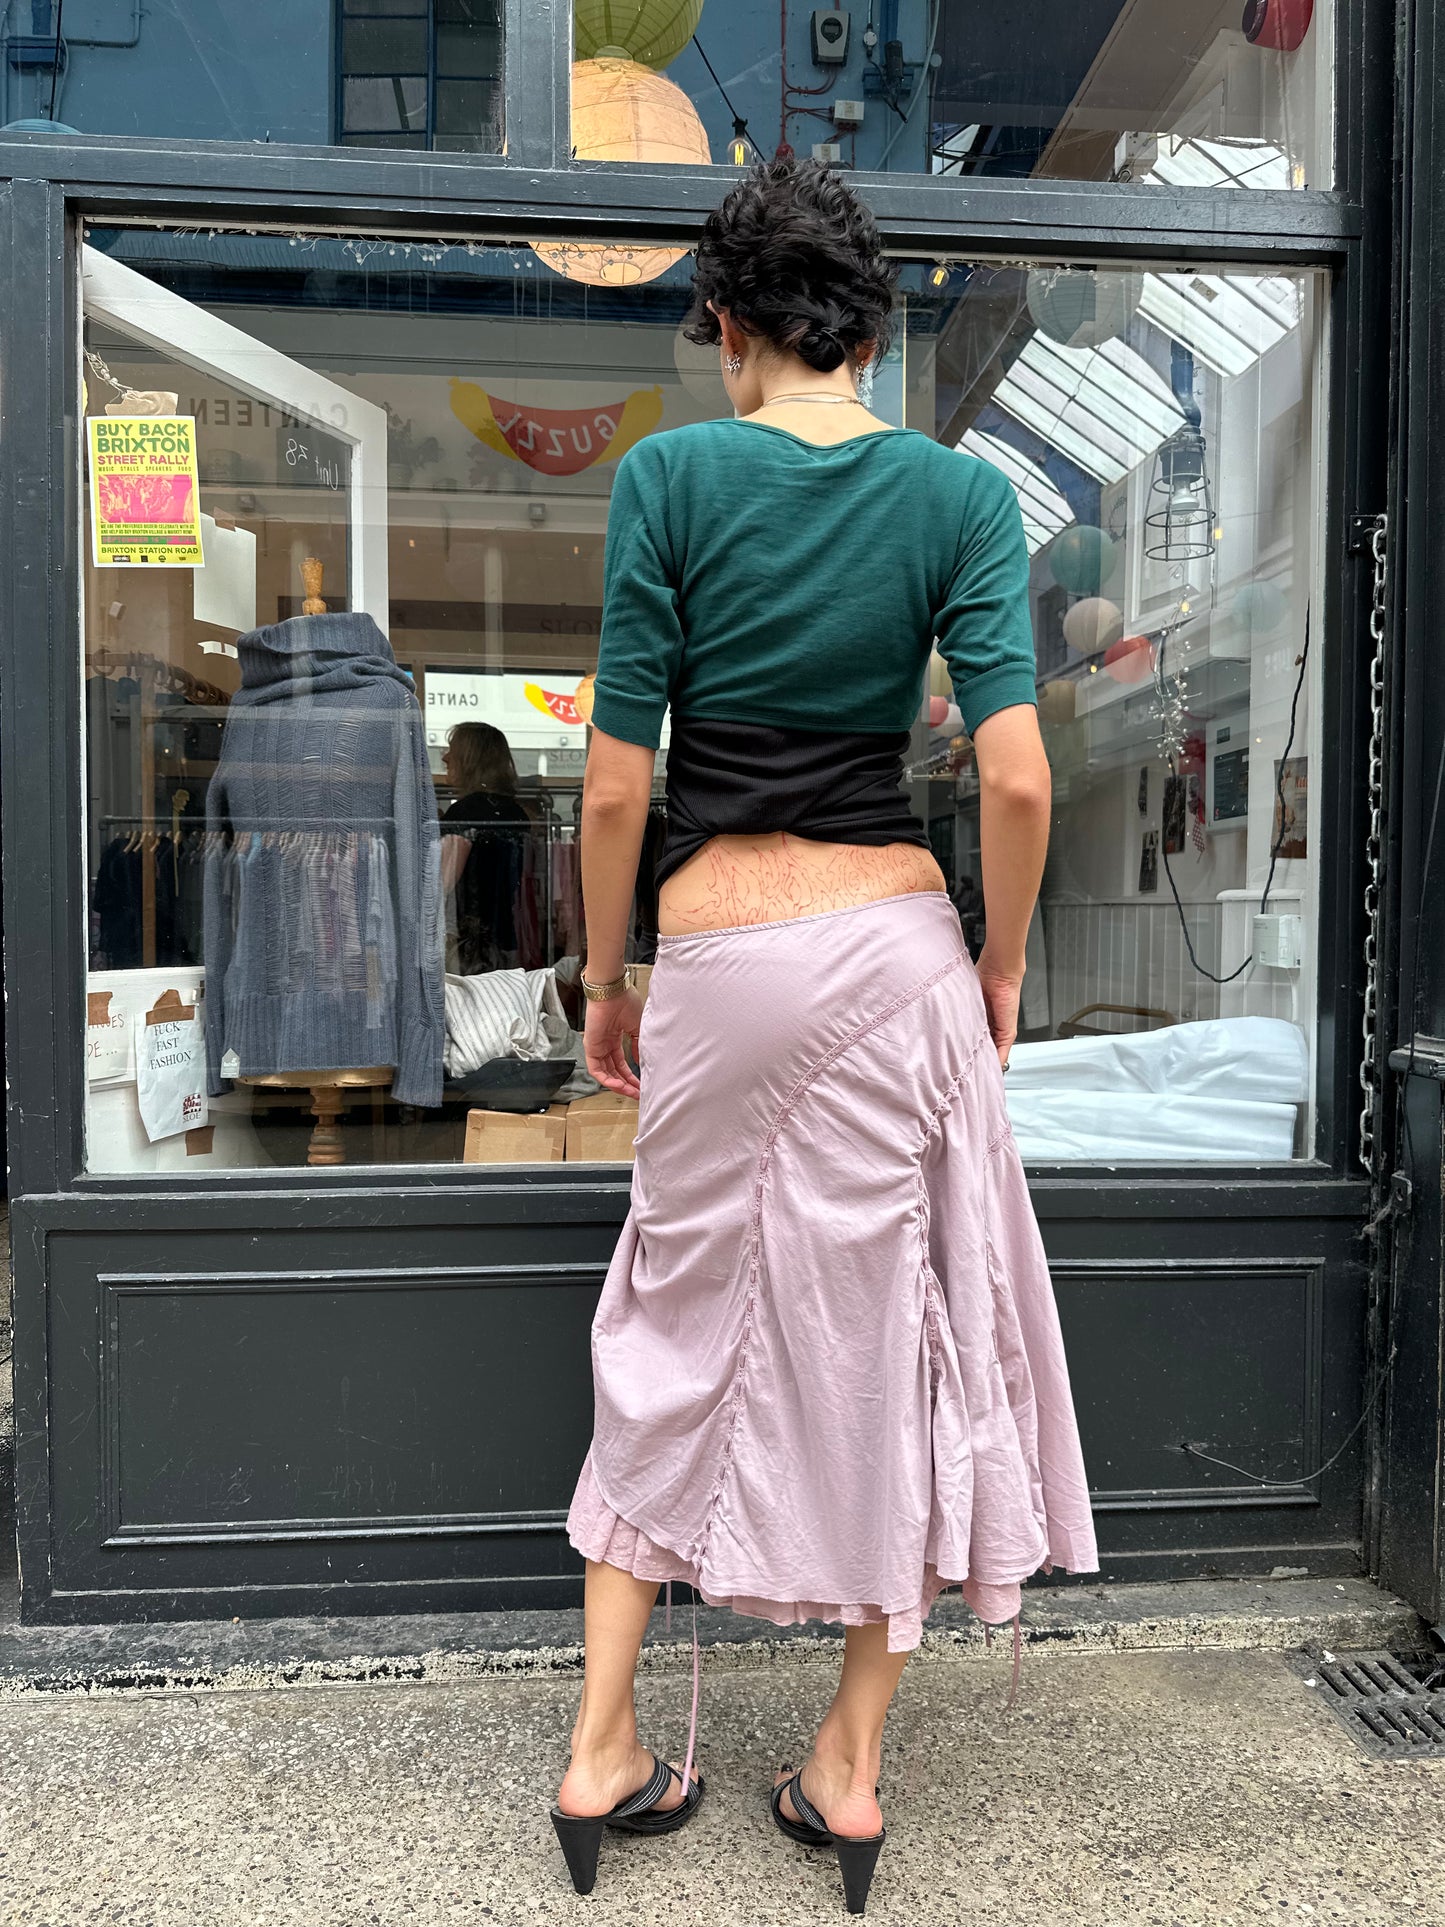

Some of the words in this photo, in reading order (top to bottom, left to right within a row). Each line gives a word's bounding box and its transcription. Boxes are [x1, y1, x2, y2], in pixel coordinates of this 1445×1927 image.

[97, 423, 133, 436] BUY
[139, 423, 188, 436] BACK
[97, 437, 190, 453] BRIXTON
[97, 455, 145, 465] STREET
[150, 455, 189, 465] RALLY
[153, 1021, 180, 1037] FUCK
[156, 1037, 180, 1052] FAST
[150, 1050, 192, 1070] FASHION
